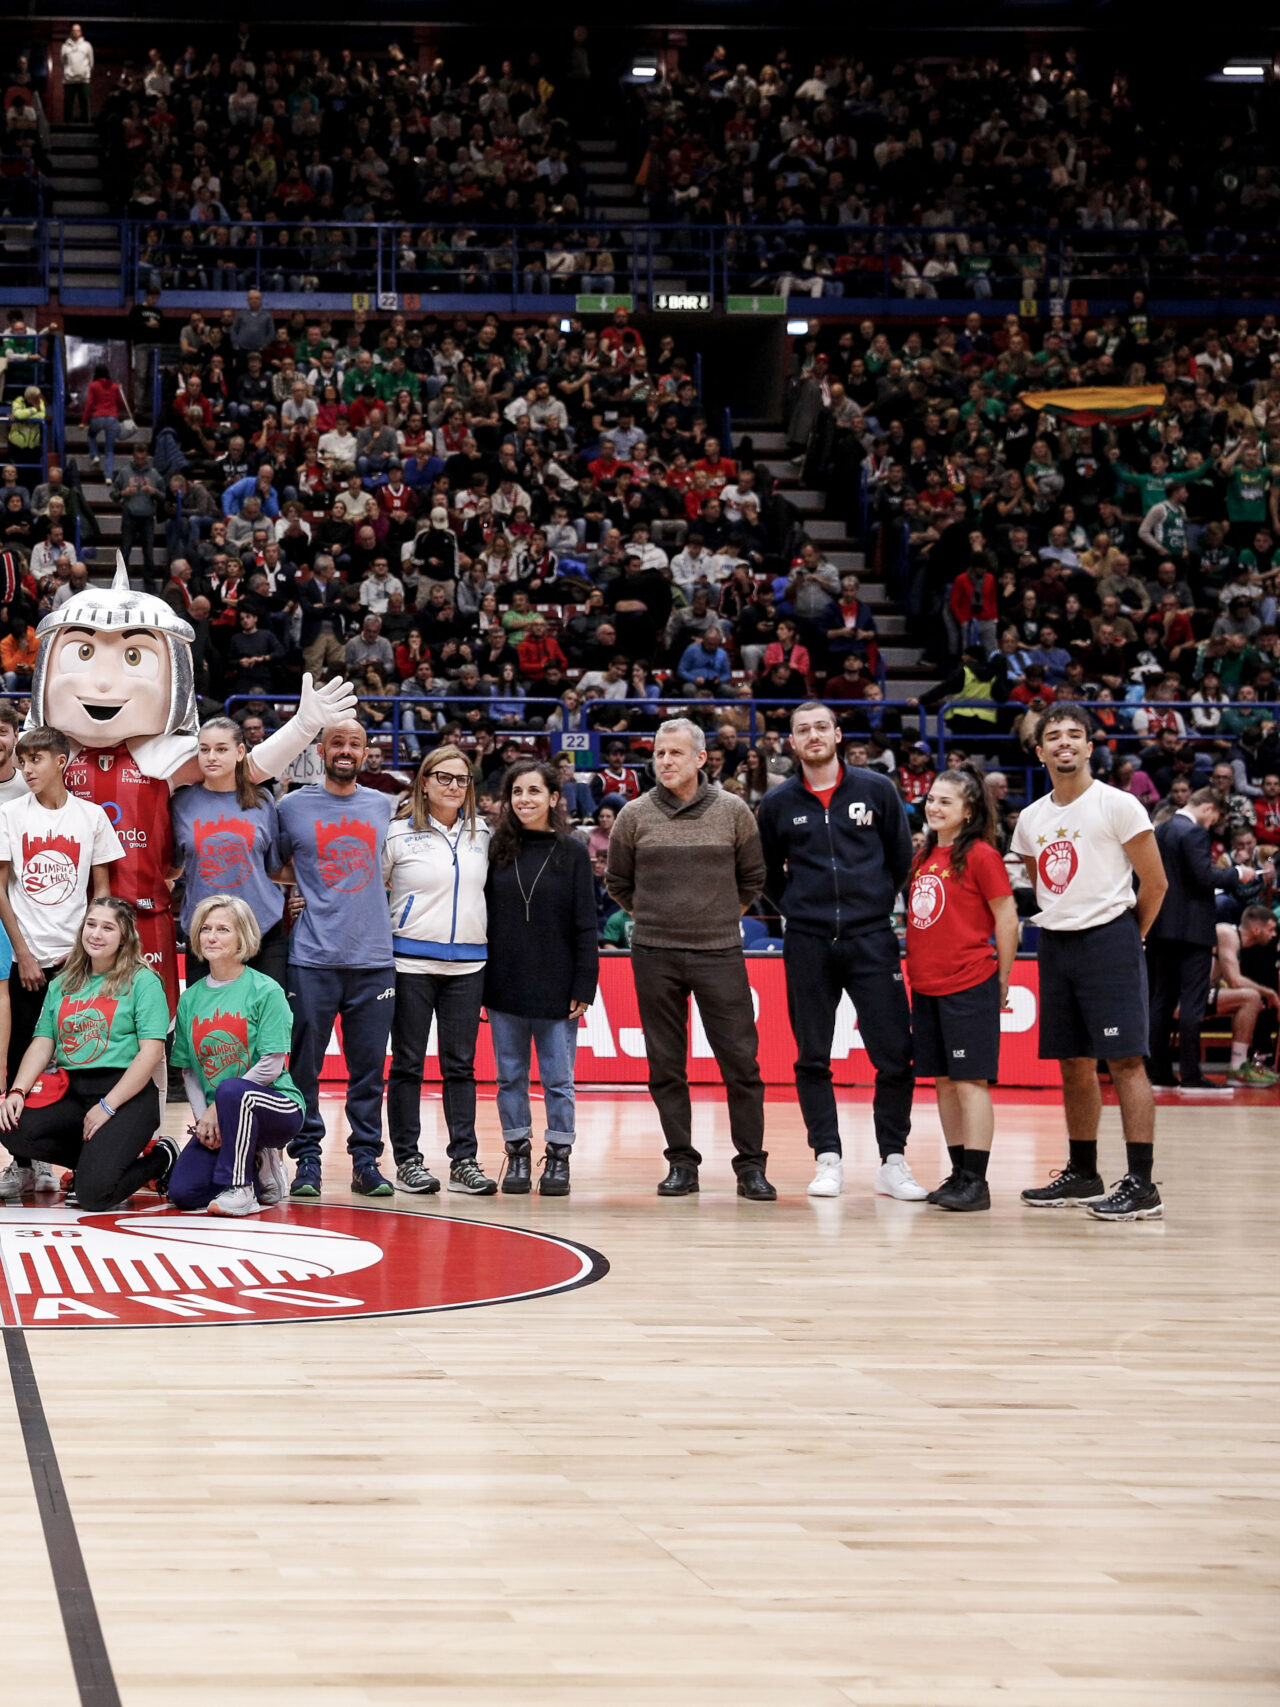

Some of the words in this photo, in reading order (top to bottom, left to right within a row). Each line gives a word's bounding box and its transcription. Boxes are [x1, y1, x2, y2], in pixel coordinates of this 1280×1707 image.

[669, 295, 699, 309] BAR
[566, 735, 585, 748] 22
[121, 777, 151, 785] EYEWEAR
[793, 816, 808, 824] EA7
[1104, 1027, 1119, 1036] EA7
[953, 1050, 965, 1058] EA7
